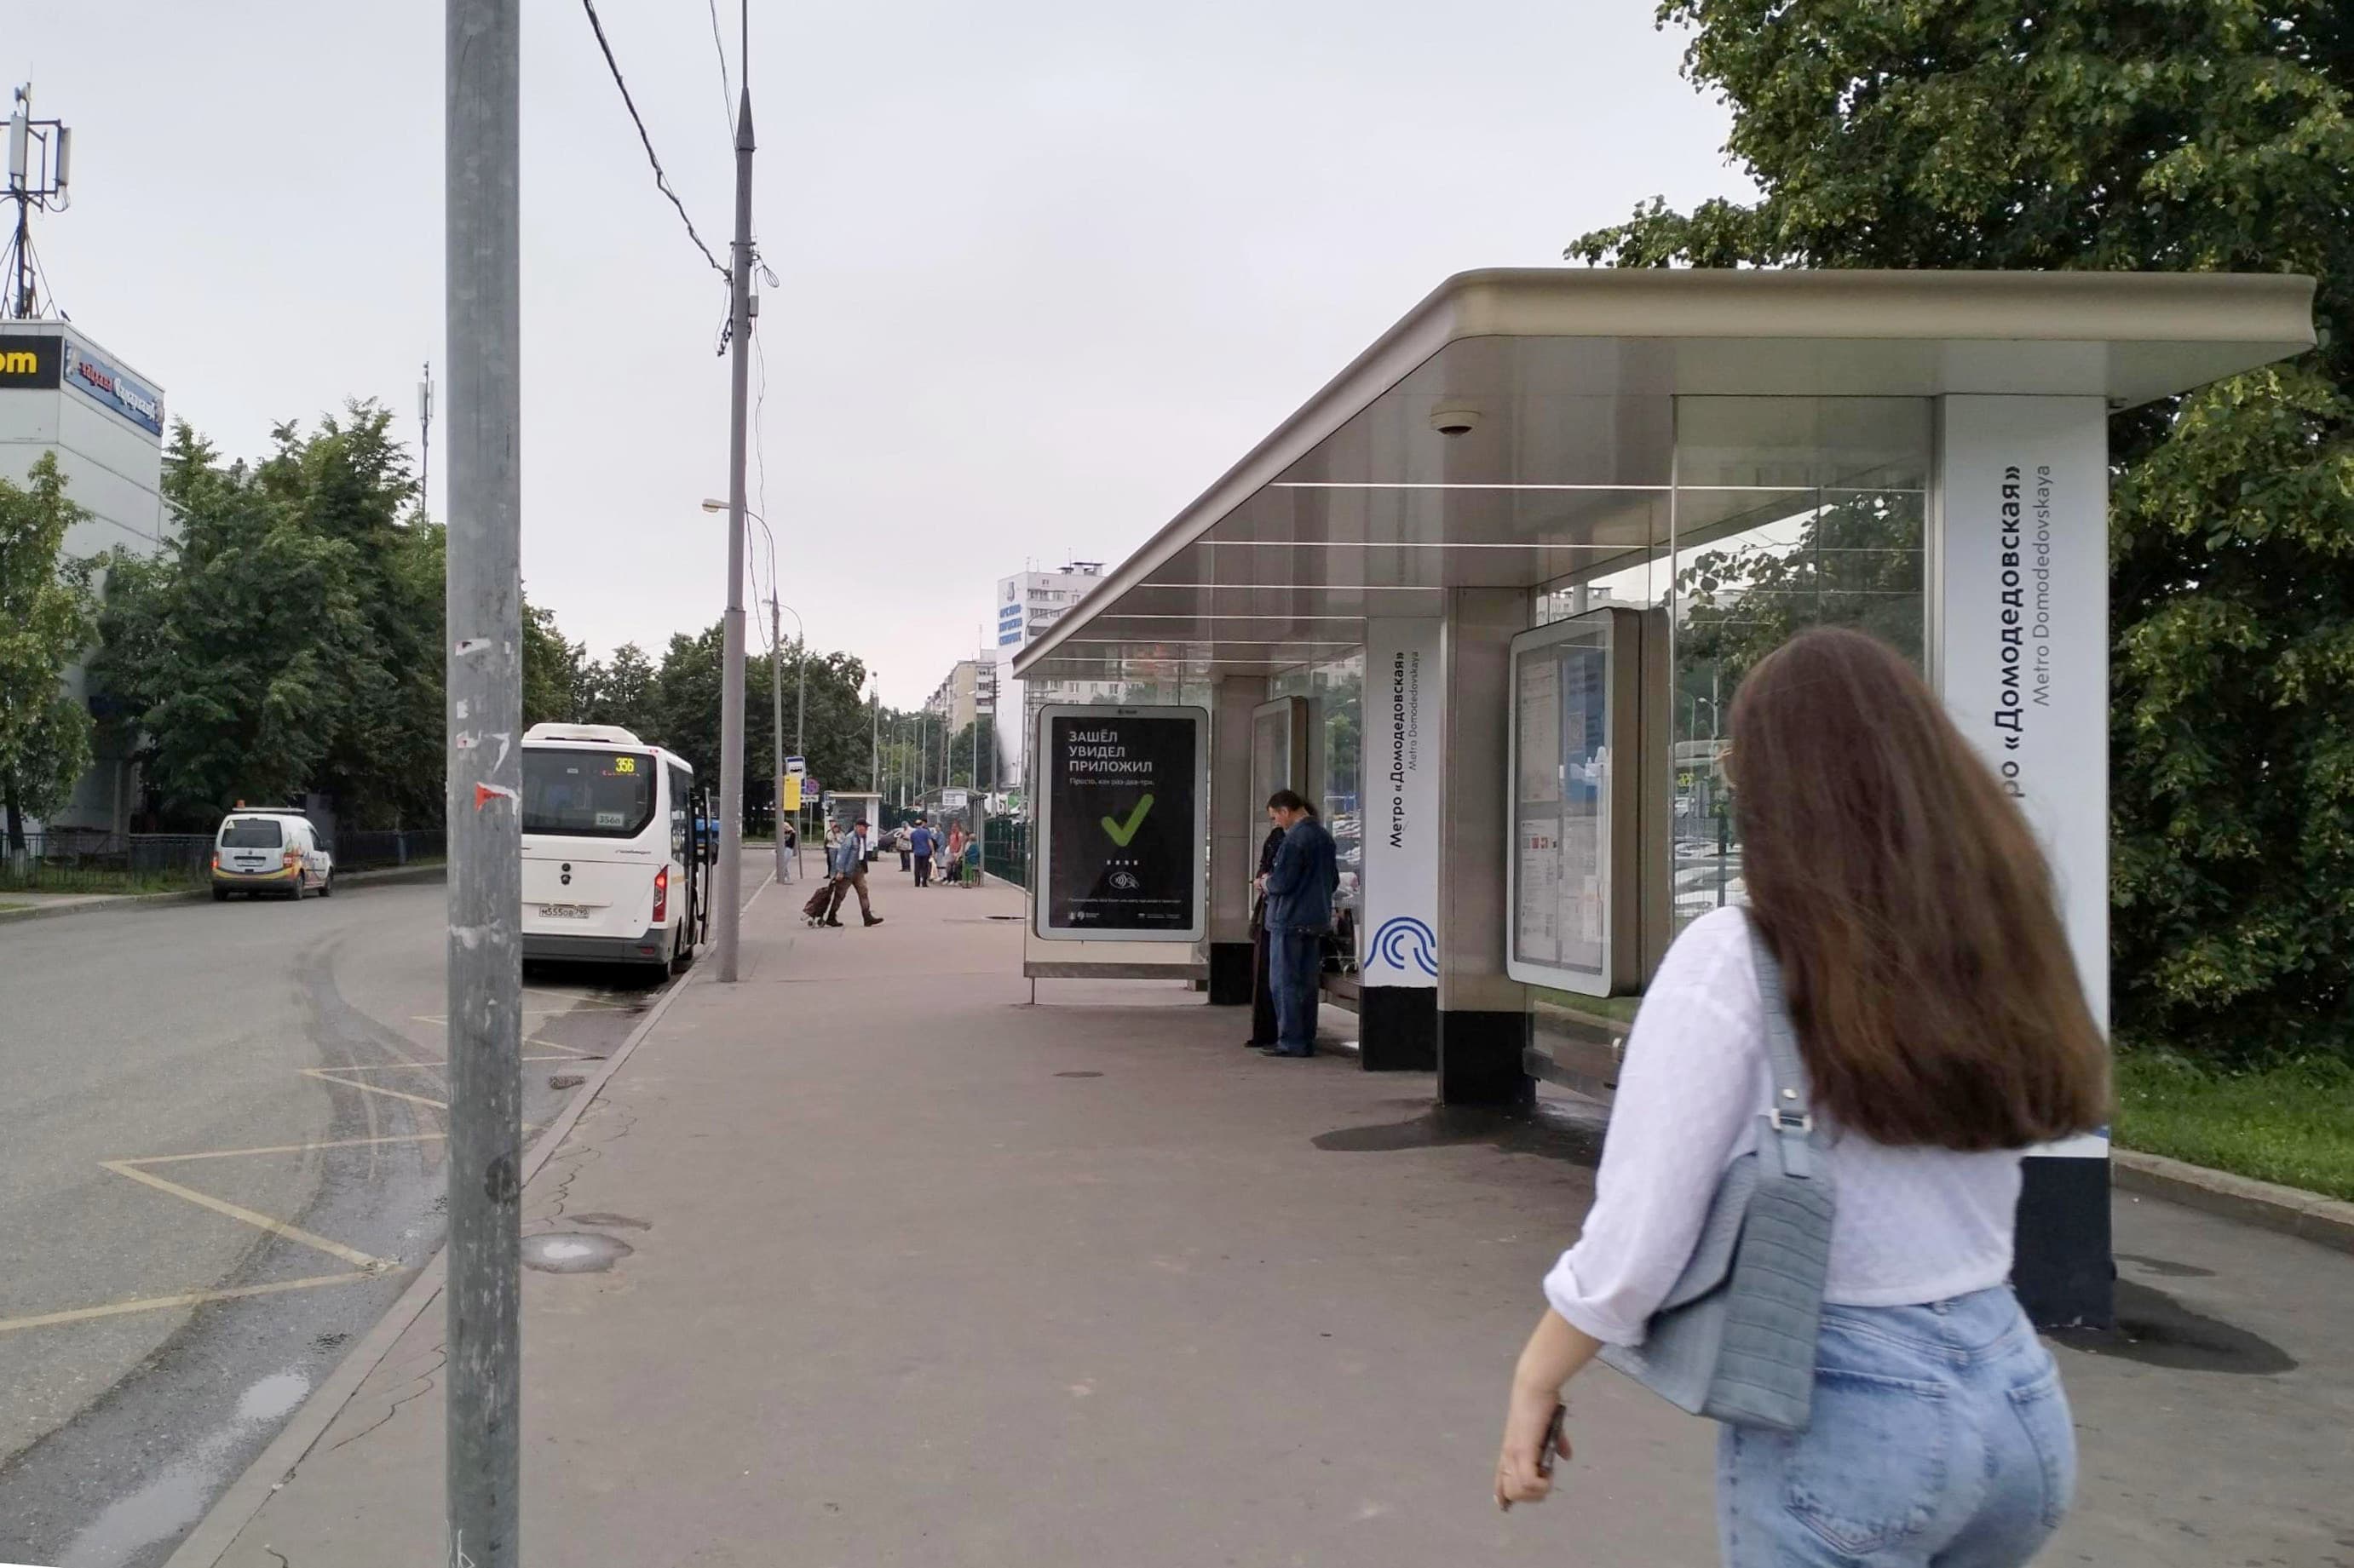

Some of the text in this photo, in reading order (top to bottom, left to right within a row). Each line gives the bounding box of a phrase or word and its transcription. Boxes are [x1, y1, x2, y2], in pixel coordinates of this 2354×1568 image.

[2031, 466, 2053, 706] Metro Domodedovskaya
[1994, 466, 2025, 797] ро «Домодедовская»
[1069, 729, 1118, 742] ЗАШЁЛ
[1408, 652, 1419, 770] Metro Domodedovskaya
[615, 757, 635, 773] 356
[1069, 746, 1125, 759] УВИДЕЛ
[1069, 761, 1153, 773] ПРИЛОЖИЛ
[1390, 652, 1405, 848] Метро «Домодедовская»
